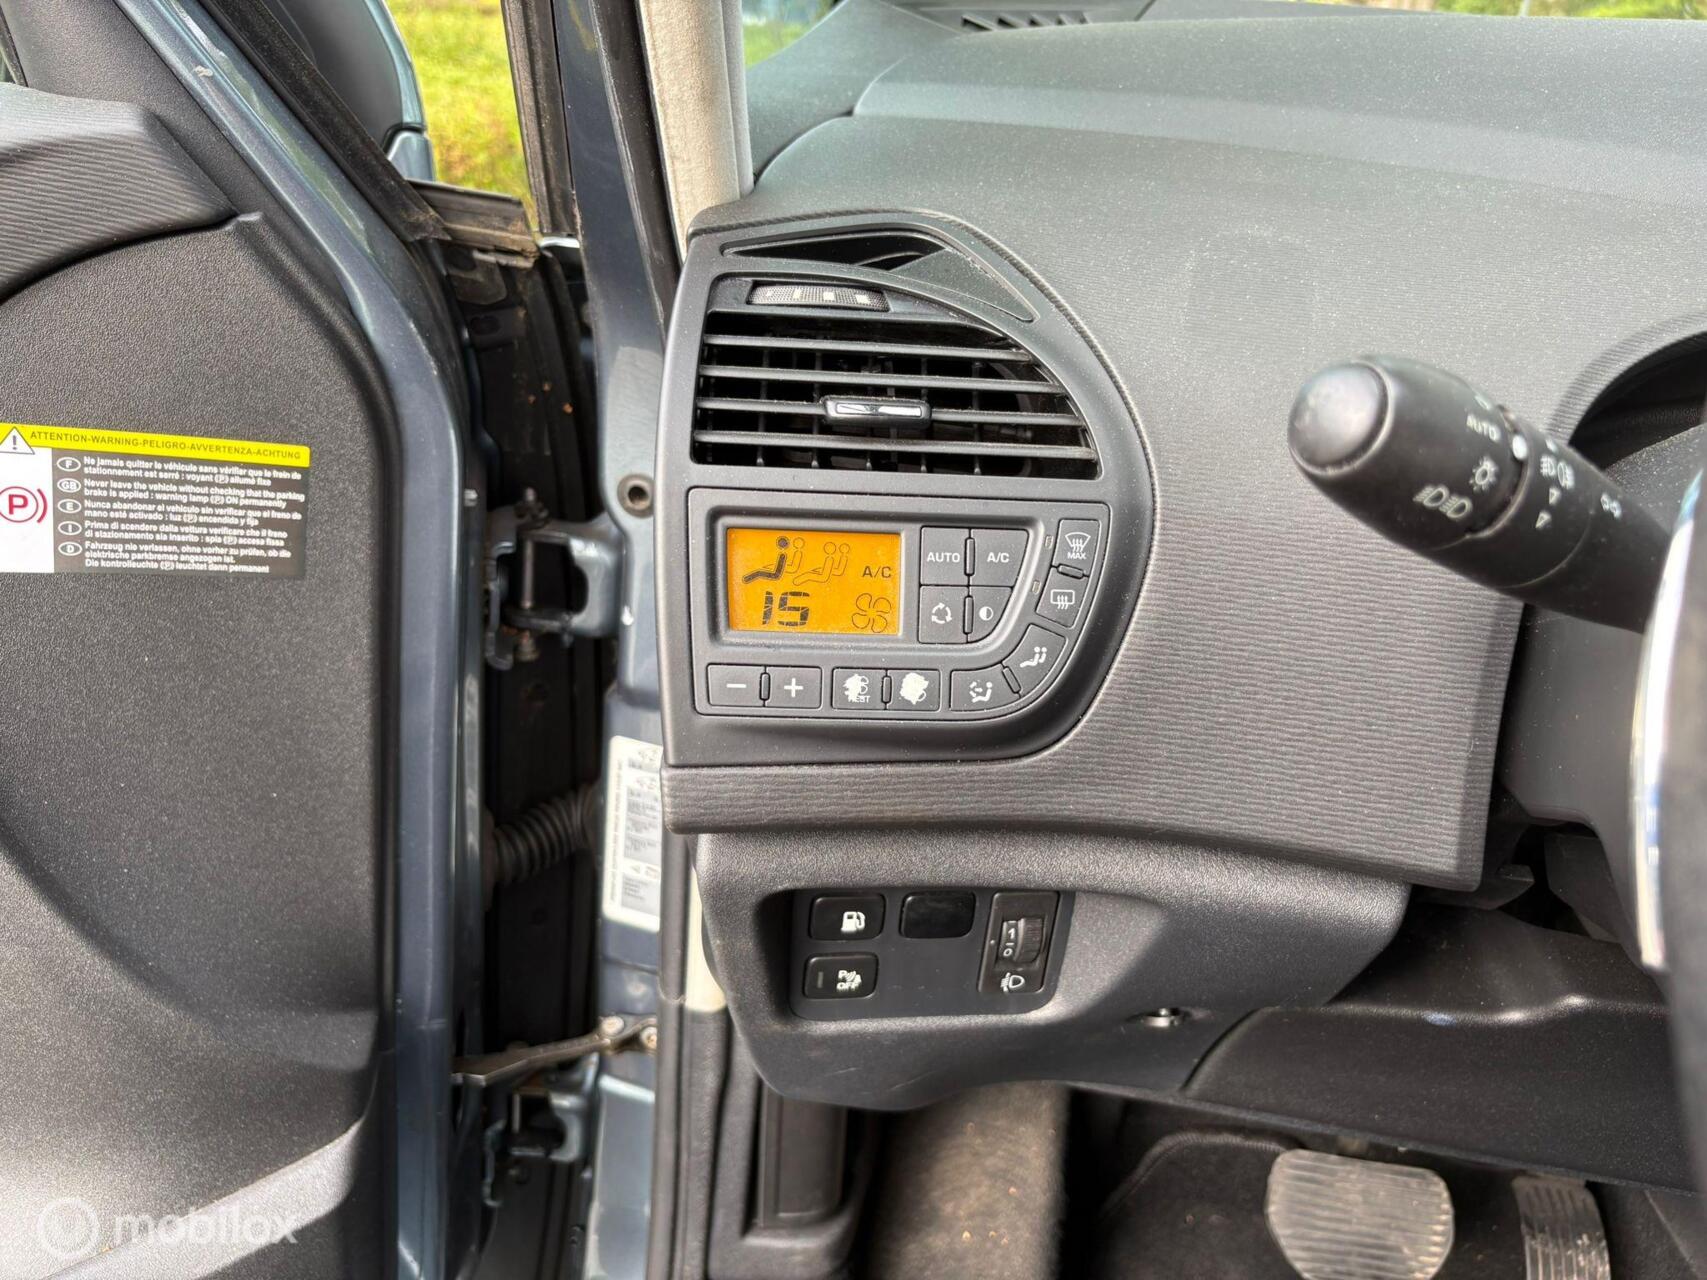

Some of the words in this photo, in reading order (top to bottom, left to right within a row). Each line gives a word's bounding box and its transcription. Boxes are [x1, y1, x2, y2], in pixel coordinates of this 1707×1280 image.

[1466, 414, 1500, 442] AUTO
[84, 479, 108, 487] Never
[926, 551, 961, 563] AUTO
[986, 551, 1010, 563] A/C
[1067, 552, 1086, 560] MAX
[862, 566, 892, 579] A/C
[1008, 928, 1015, 939] 1
